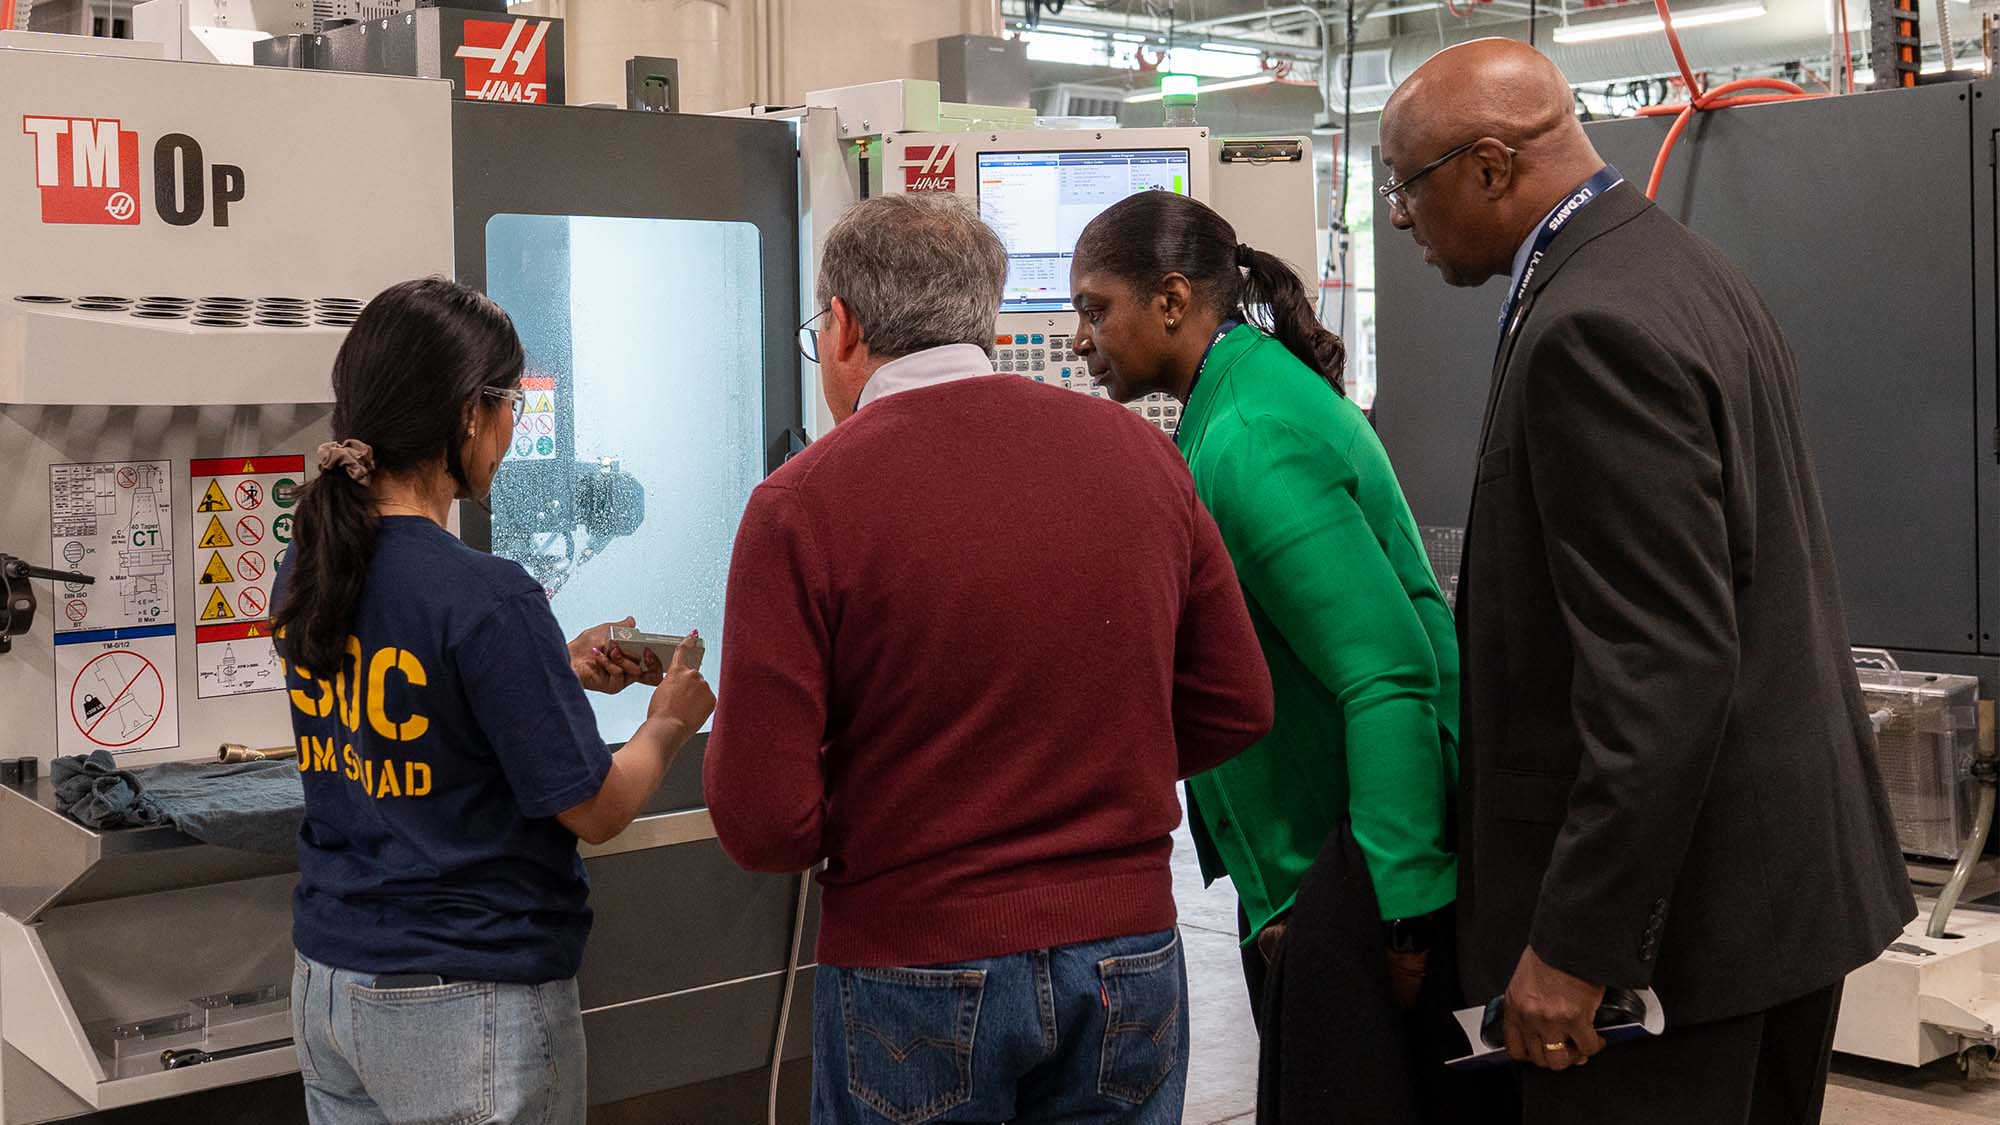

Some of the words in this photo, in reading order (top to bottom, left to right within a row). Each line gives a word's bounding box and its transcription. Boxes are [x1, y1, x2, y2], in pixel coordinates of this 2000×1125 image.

[466, 79, 547, 104] HAAS
[24, 116, 121, 189] TM
[906, 176, 955, 190] HAAS
[133, 530, 159, 547] CT
